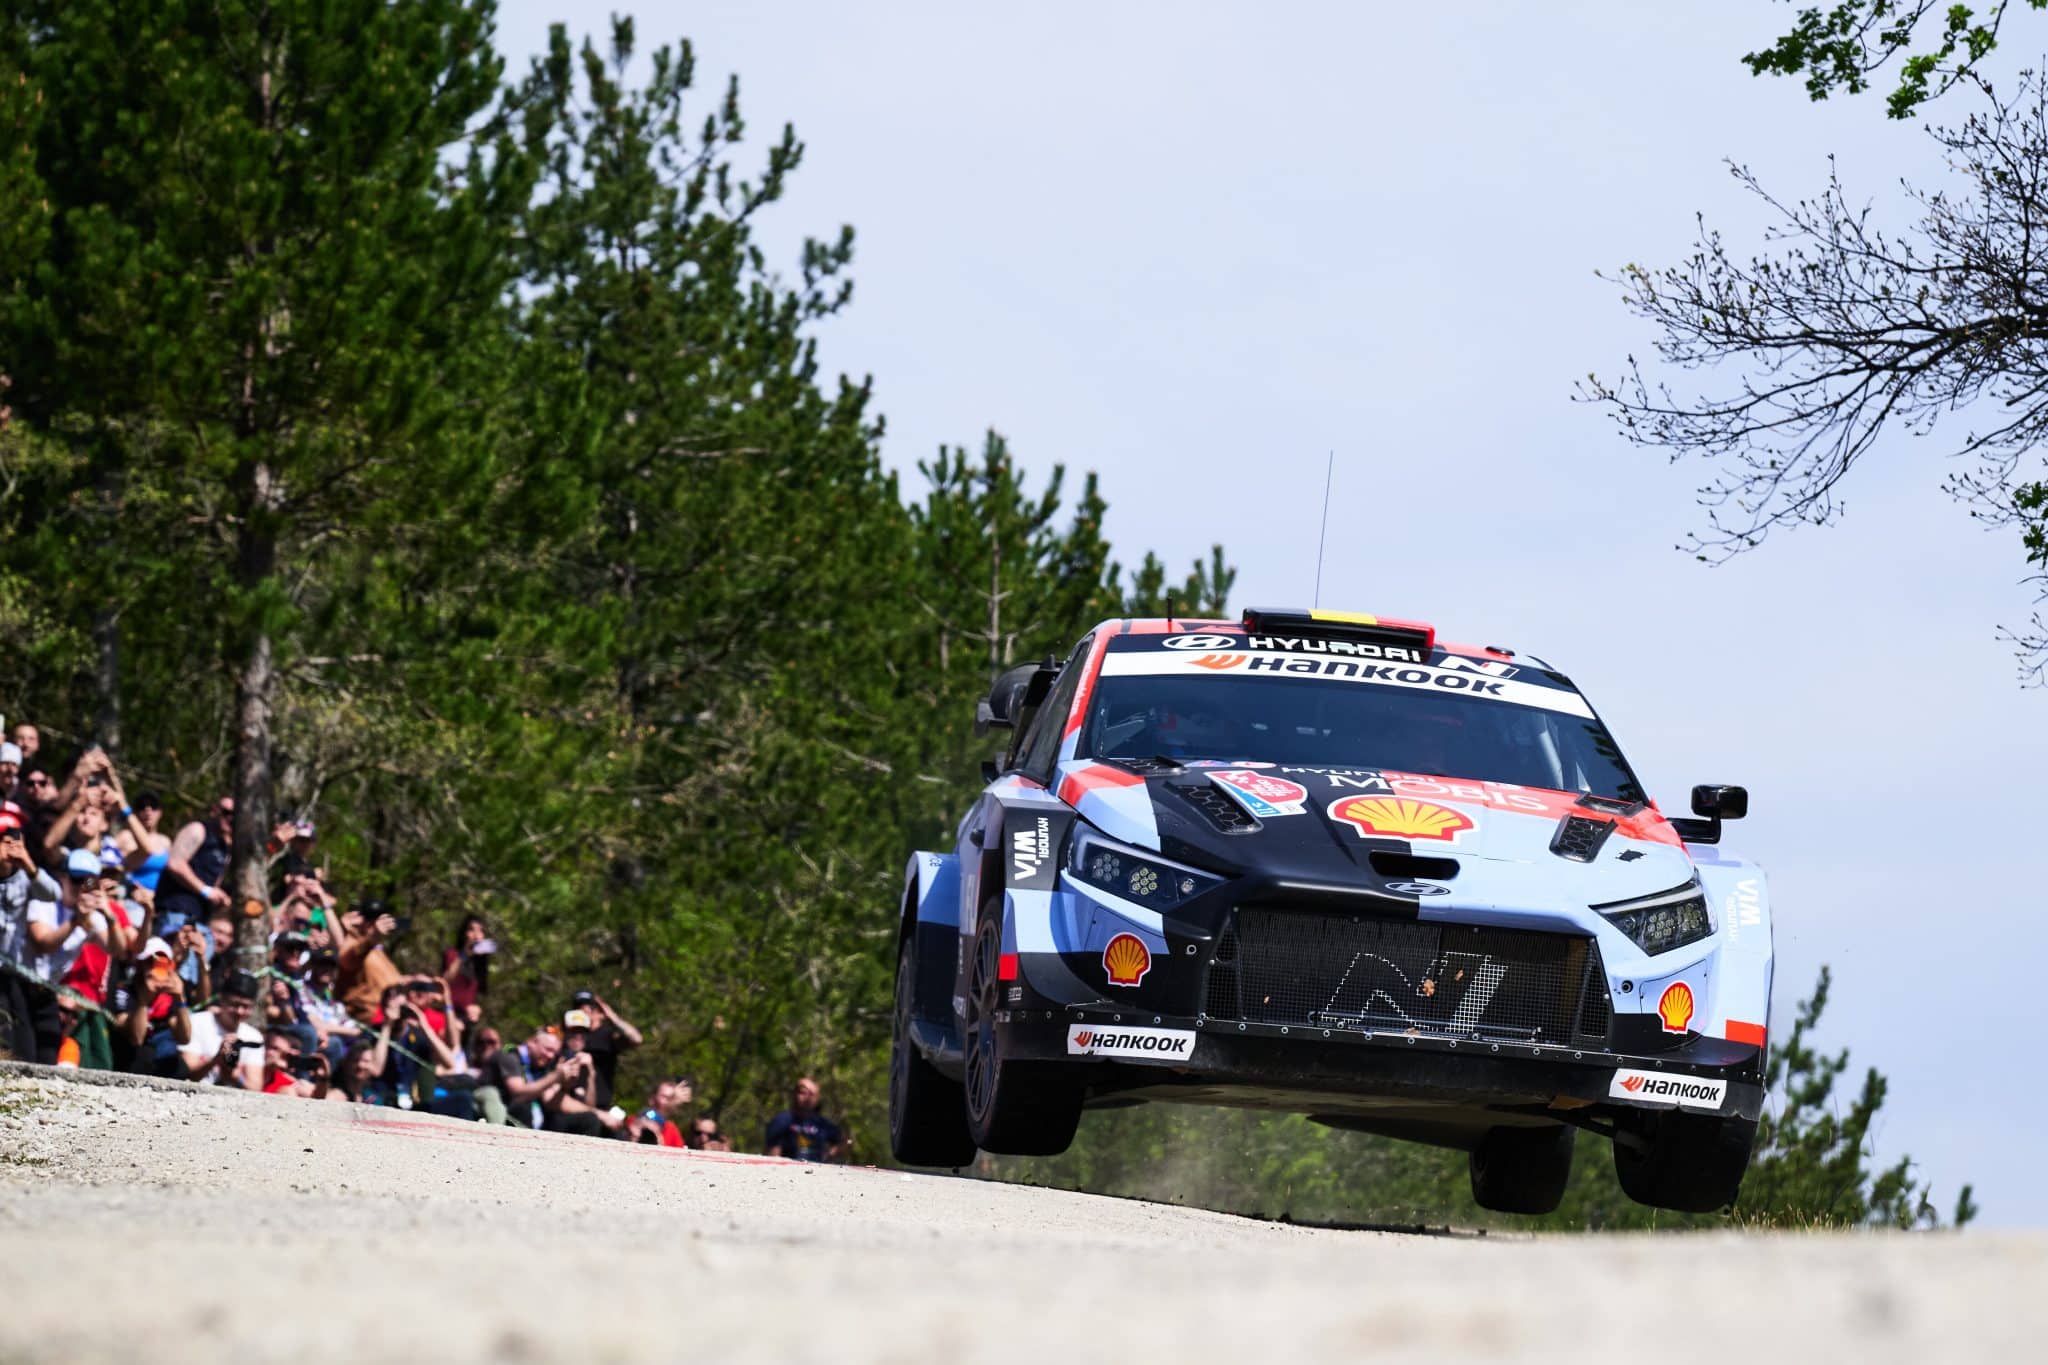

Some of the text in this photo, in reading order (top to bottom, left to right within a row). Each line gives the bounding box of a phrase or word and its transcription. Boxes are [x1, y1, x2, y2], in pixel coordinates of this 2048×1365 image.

[1249, 636, 1421, 662] HYUNDAI
[1281, 767, 1436, 783] HYUNDAI
[1325, 774, 1550, 811] MOBIS
[1038, 817, 1049, 858] HYUNDAI
[1091, 1033, 1187, 1053] HANKOOK
[1643, 1079, 1720, 1101] HANKOOK
